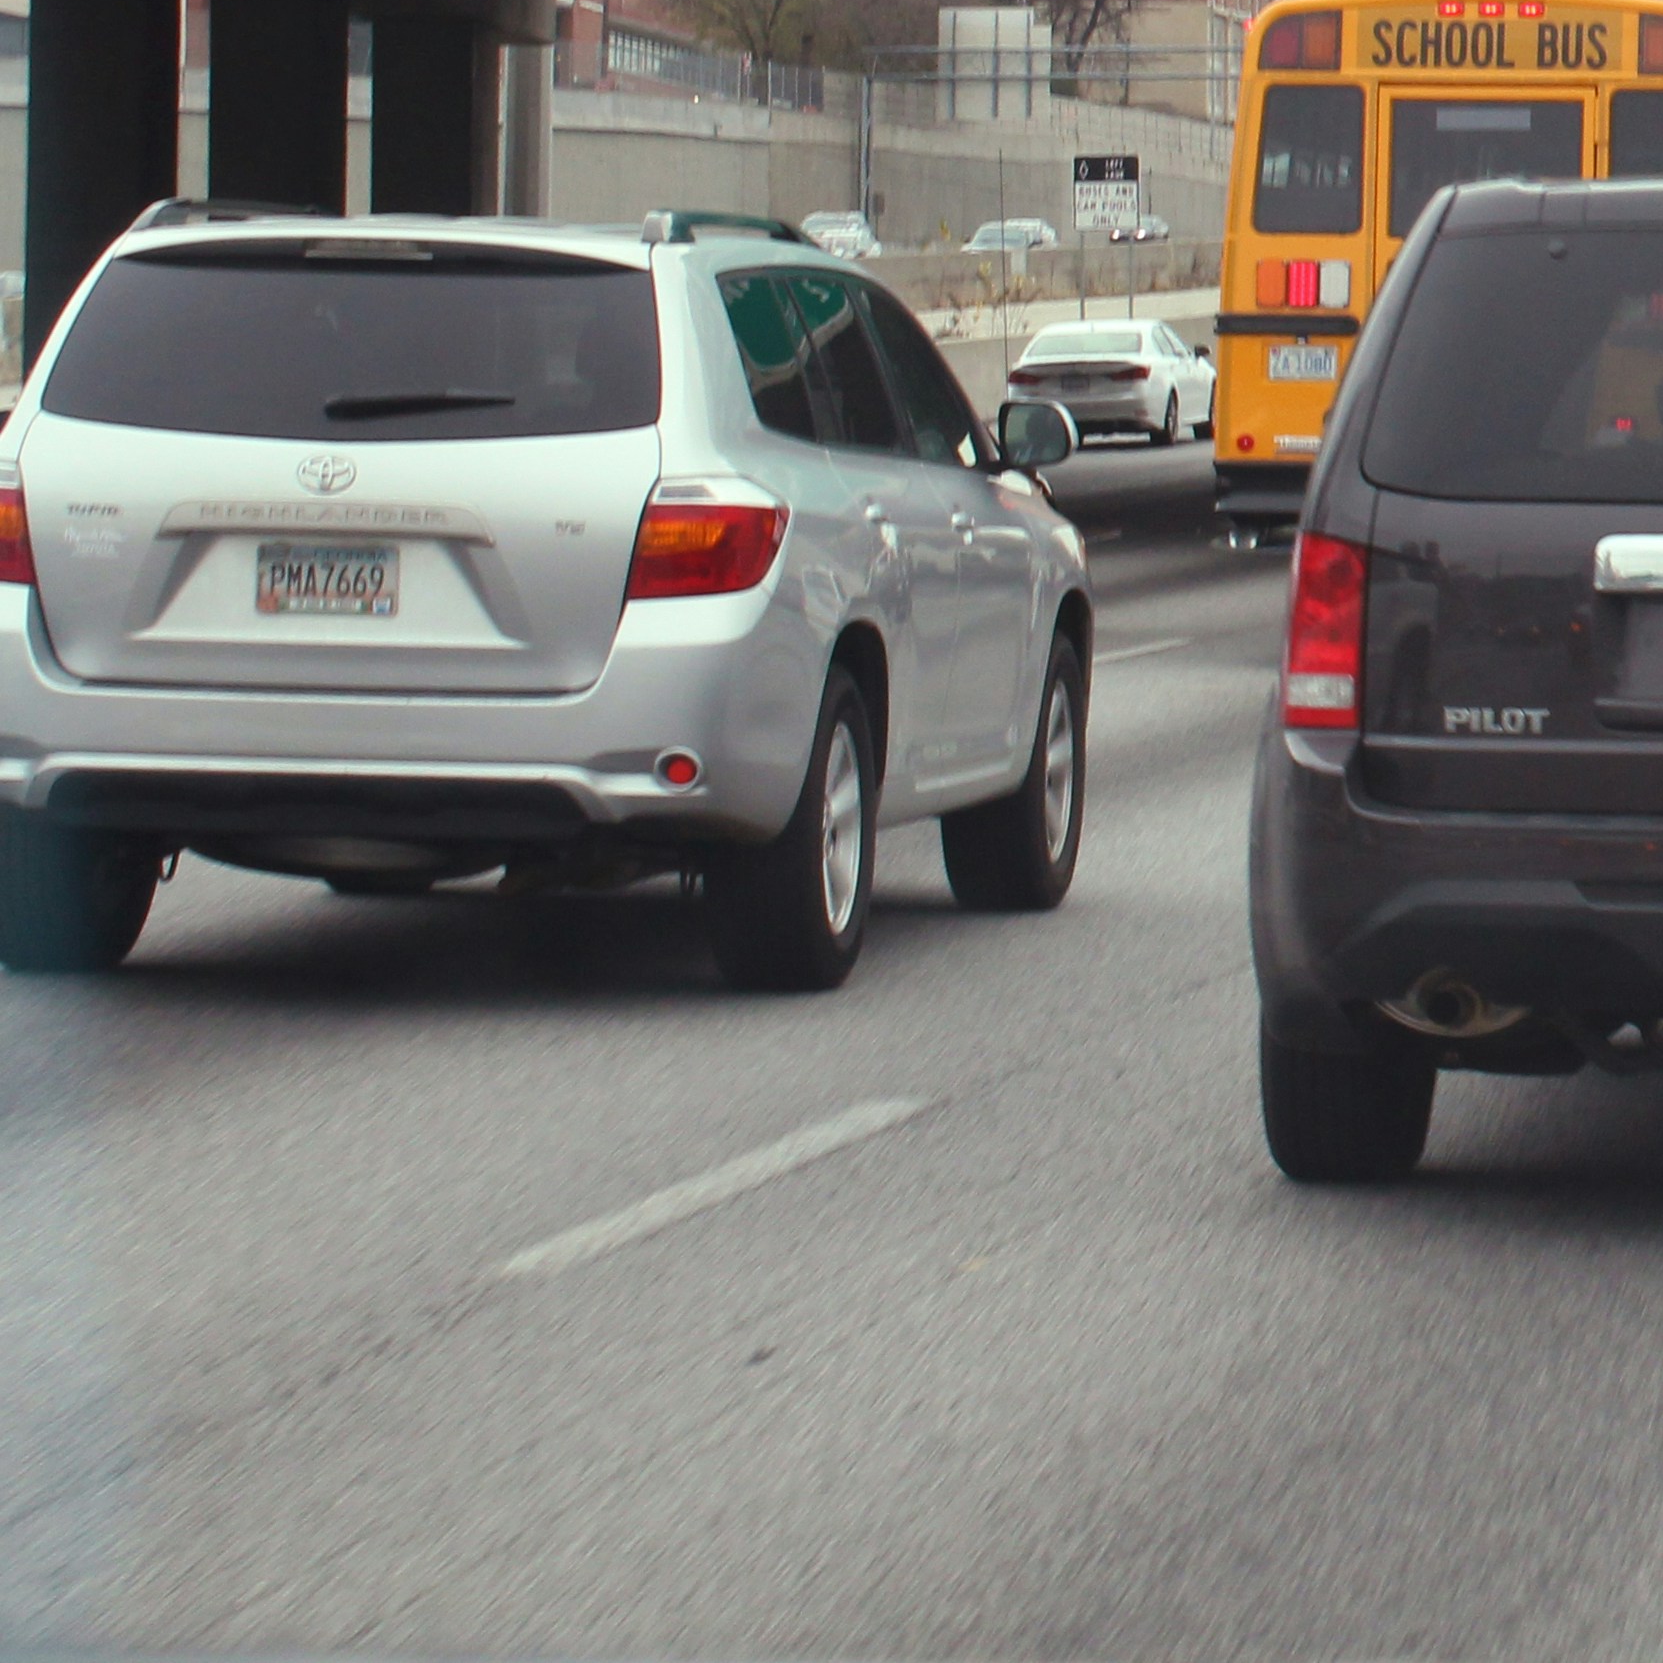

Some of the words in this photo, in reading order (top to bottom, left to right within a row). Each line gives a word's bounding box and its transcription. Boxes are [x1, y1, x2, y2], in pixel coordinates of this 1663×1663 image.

[1371, 20, 1516, 69] SCHOOL
[1536, 23, 1609, 70] BUS
[198, 505, 448, 524] HIGHLANDER
[269, 562, 385, 599] PMA7669
[1443, 706, 1550, 734] PILOT
